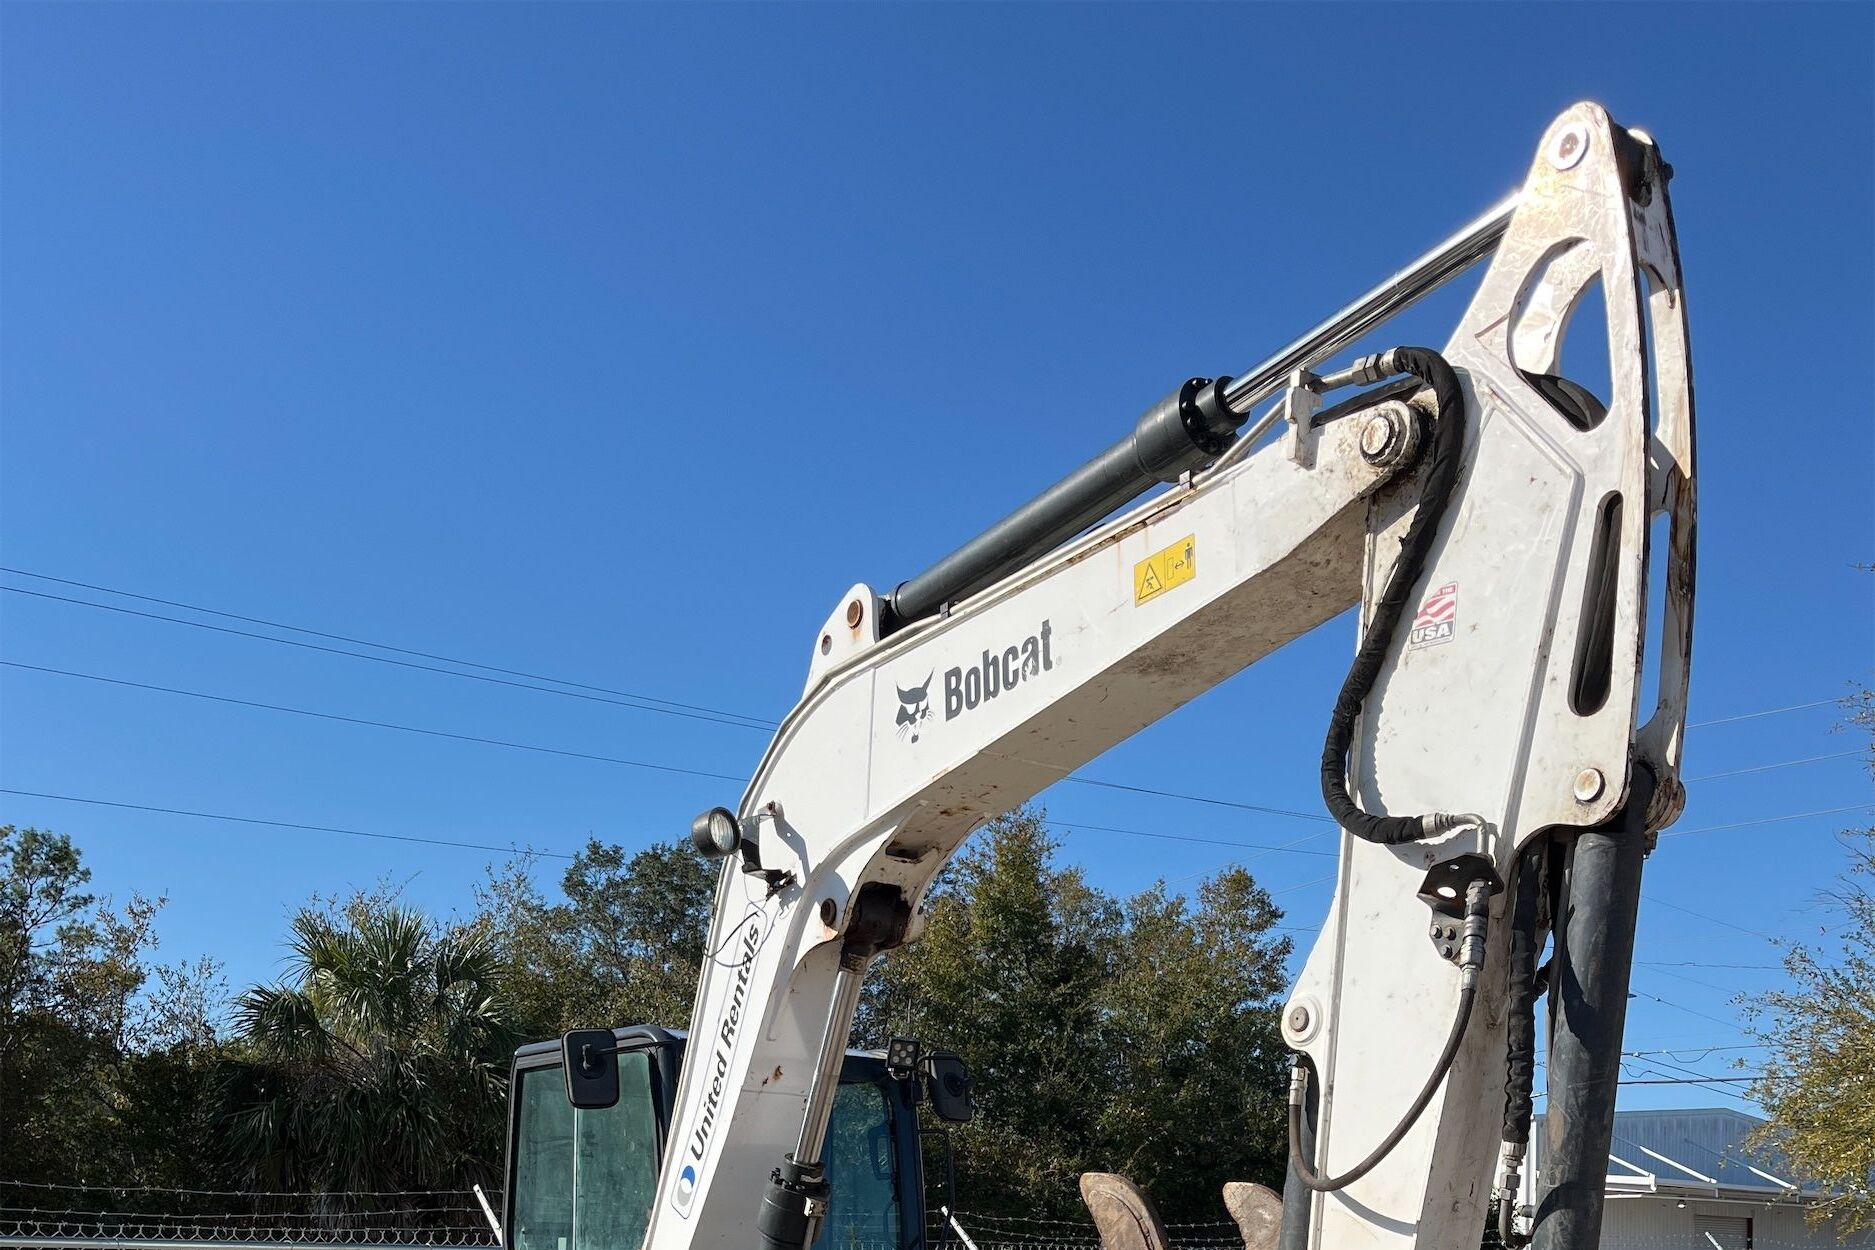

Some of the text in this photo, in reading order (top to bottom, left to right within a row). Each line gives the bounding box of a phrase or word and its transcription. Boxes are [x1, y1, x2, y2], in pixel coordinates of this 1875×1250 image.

[944, 618, 1053, 722] Bobcat
[1411, 623, 1451, 643] USA
[690, 923, 759, 1161] United Rentals
